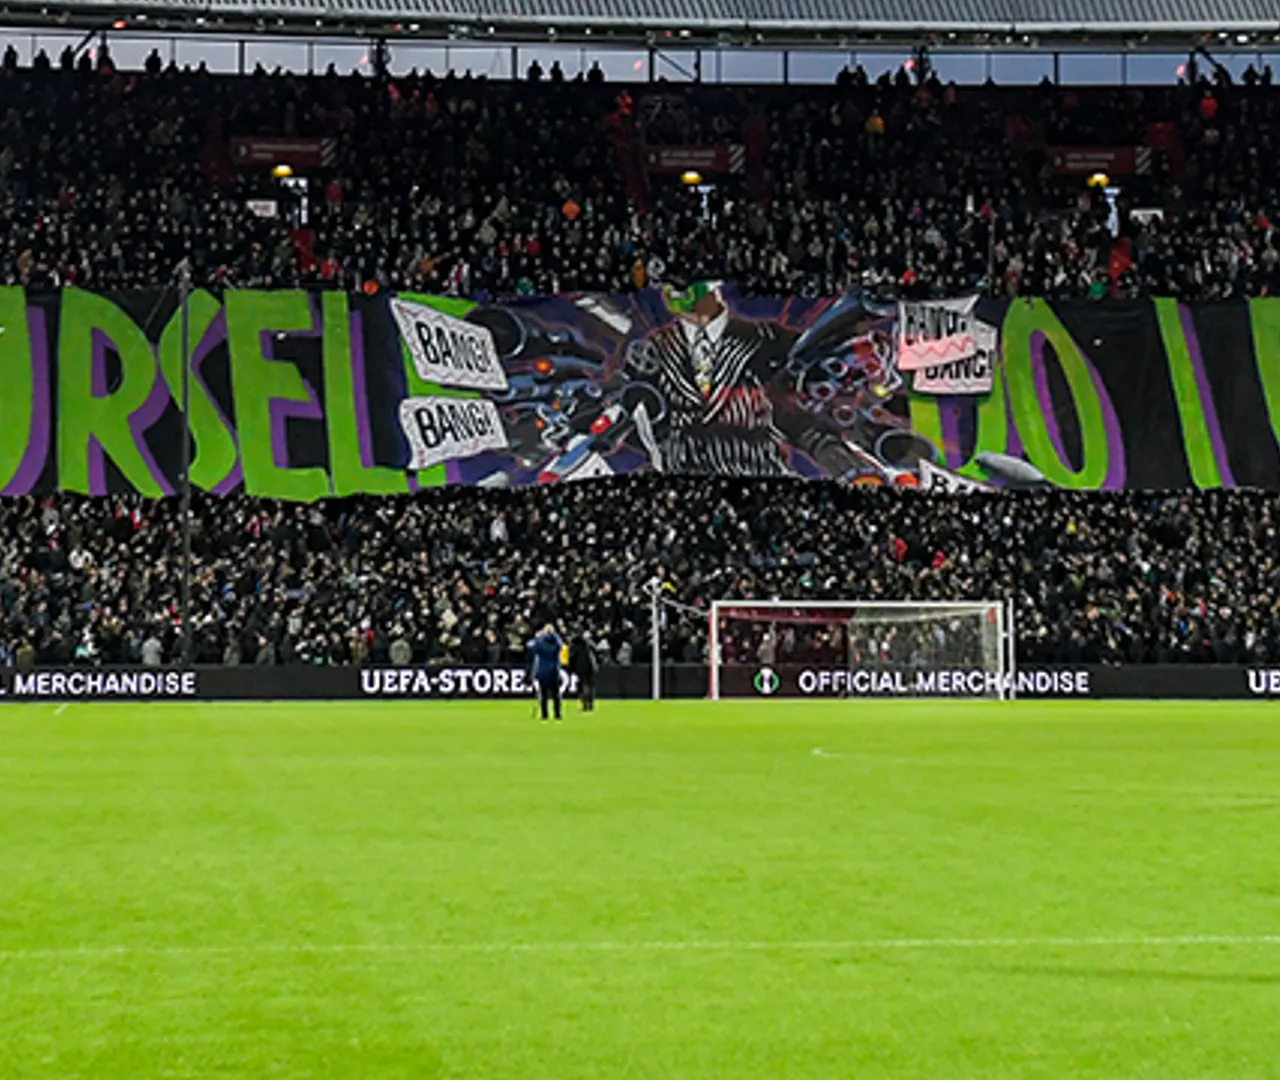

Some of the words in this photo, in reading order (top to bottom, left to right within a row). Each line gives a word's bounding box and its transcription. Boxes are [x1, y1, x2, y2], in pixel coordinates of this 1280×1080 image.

[414, 320, 494, 375] BANG!
[1152, 296, 1235, 489] I
[414, 401, 495, 449] BANG!
[13, 672, 196, 695] MERCHANDISE
[798, 671, 908, 693] OFFICIAL
[915, 671, 1090, 692] MERCHANDISE
